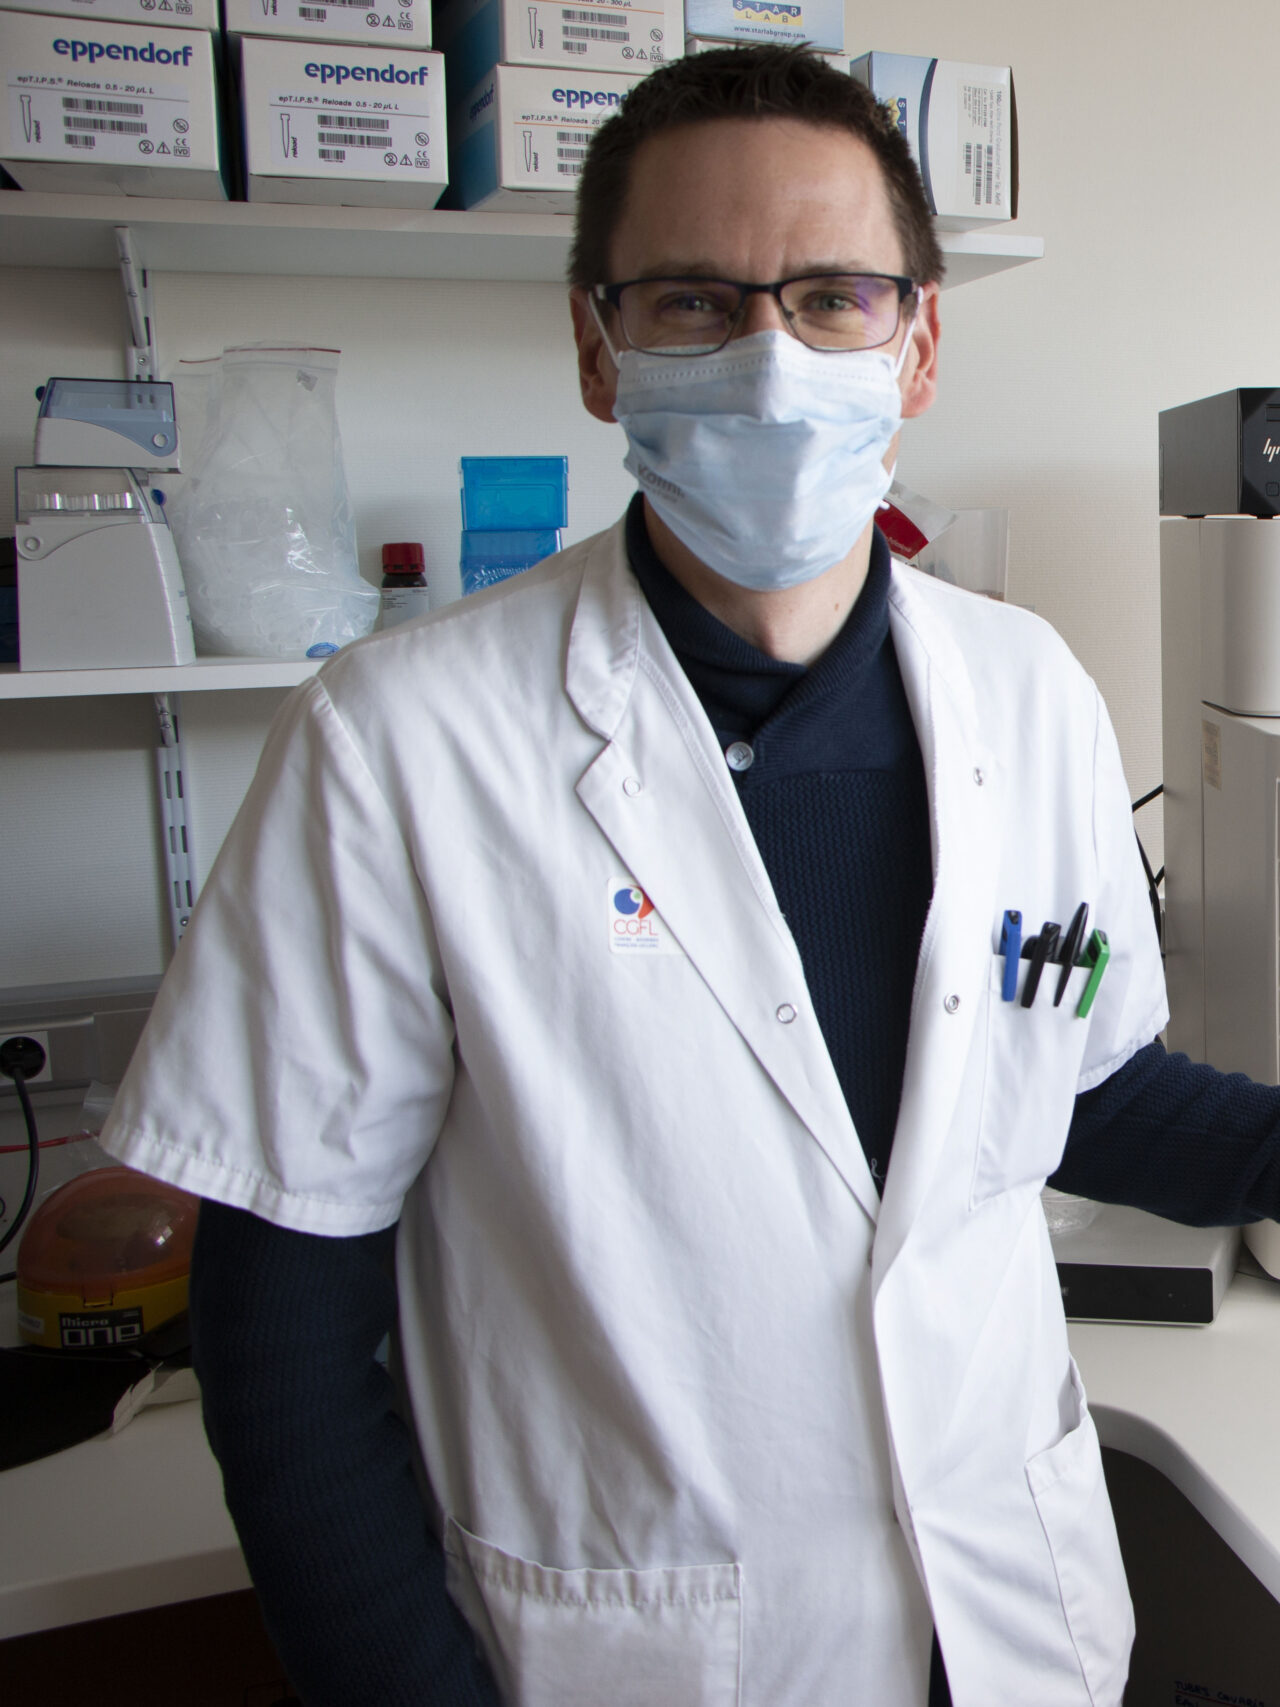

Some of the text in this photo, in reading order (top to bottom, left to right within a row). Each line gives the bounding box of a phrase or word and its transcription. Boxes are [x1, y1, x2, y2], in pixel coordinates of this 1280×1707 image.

[736, 1, 798, 16] STAR
[745, 11, 788, 23] LAB
[734, 26, 806, 39] www.starlabgroup.com
[53, 38, 193, 66] eppendorf
[304, 62, 429, 86] eppendorf
[67, 80, 100, 90] Reloads
[322, 98, 352, 107] Reloads
[561, 116, 589, 124] Reloads
[614, 919, 659, 936] CGFL
[63, 1323, 140, 1347] one
